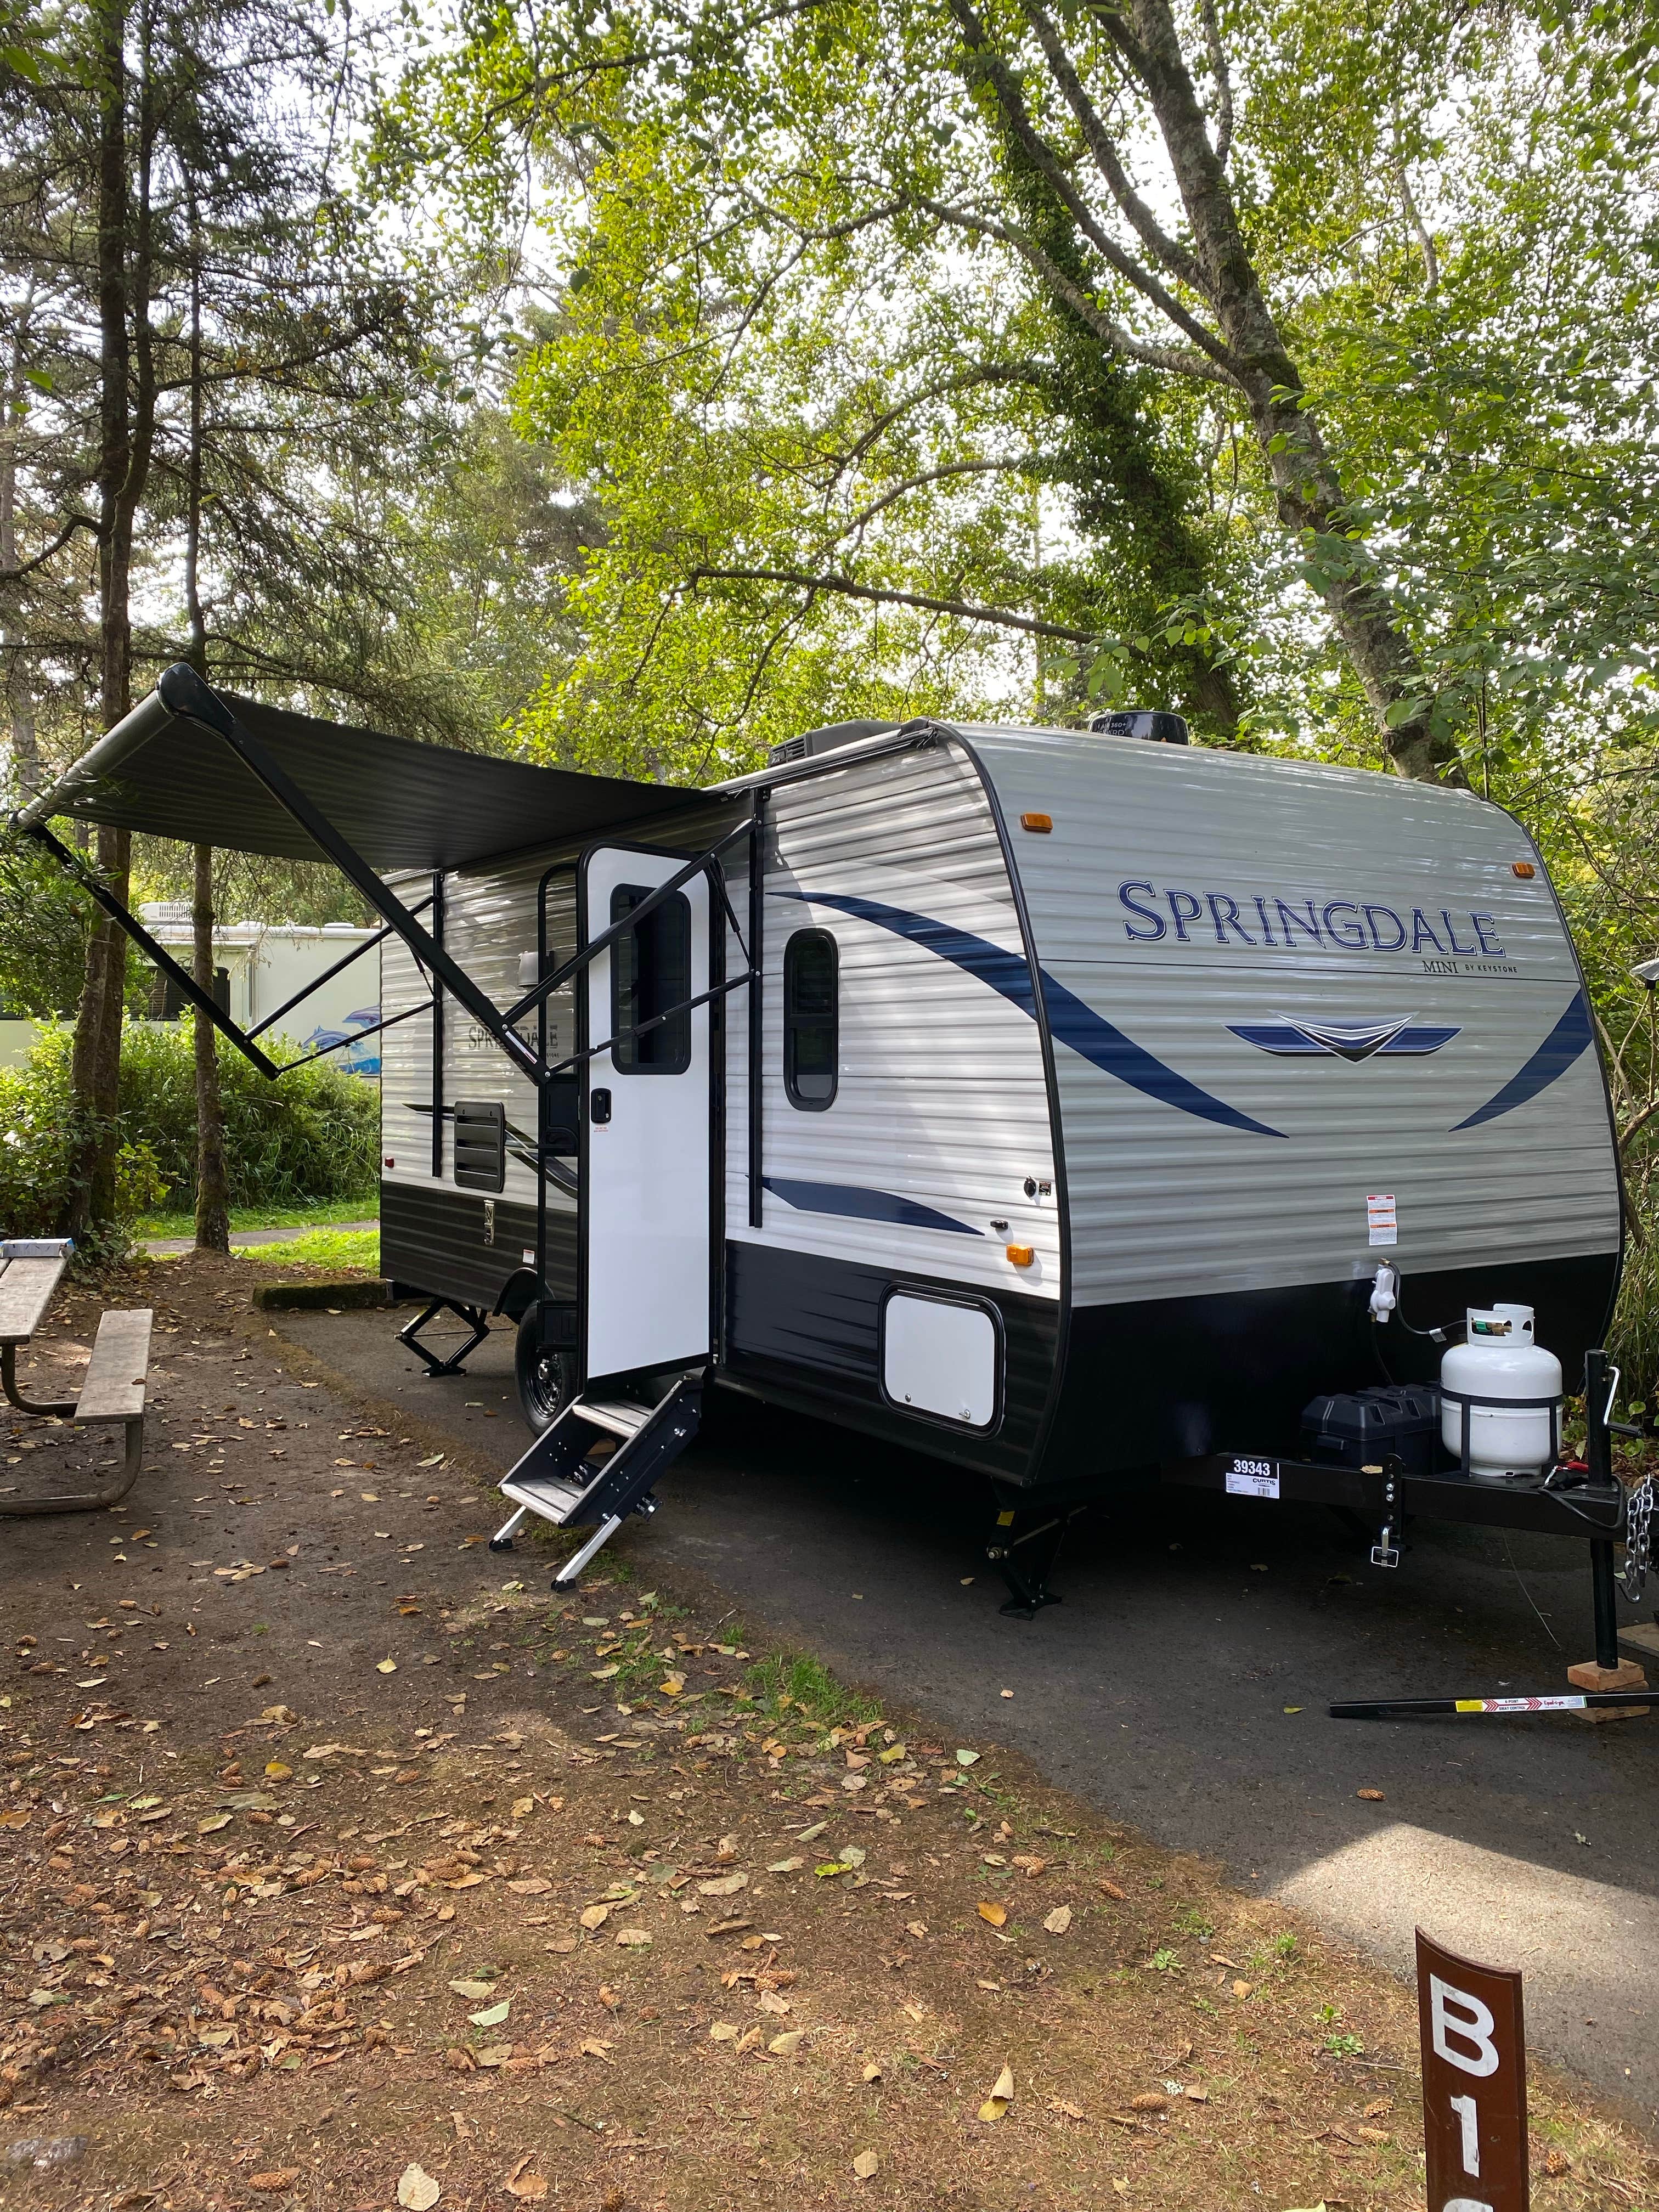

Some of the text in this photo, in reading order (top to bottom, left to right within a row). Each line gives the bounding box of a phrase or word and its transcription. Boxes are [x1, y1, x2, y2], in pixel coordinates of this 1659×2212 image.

[1118, 881, 1506, 957] SPRINGDALE
[1422, 961, 1459, 973] MINI
[1234, 1459, 1270, 1476] 39343
[1430, 1973, 1499, 2212] B1
